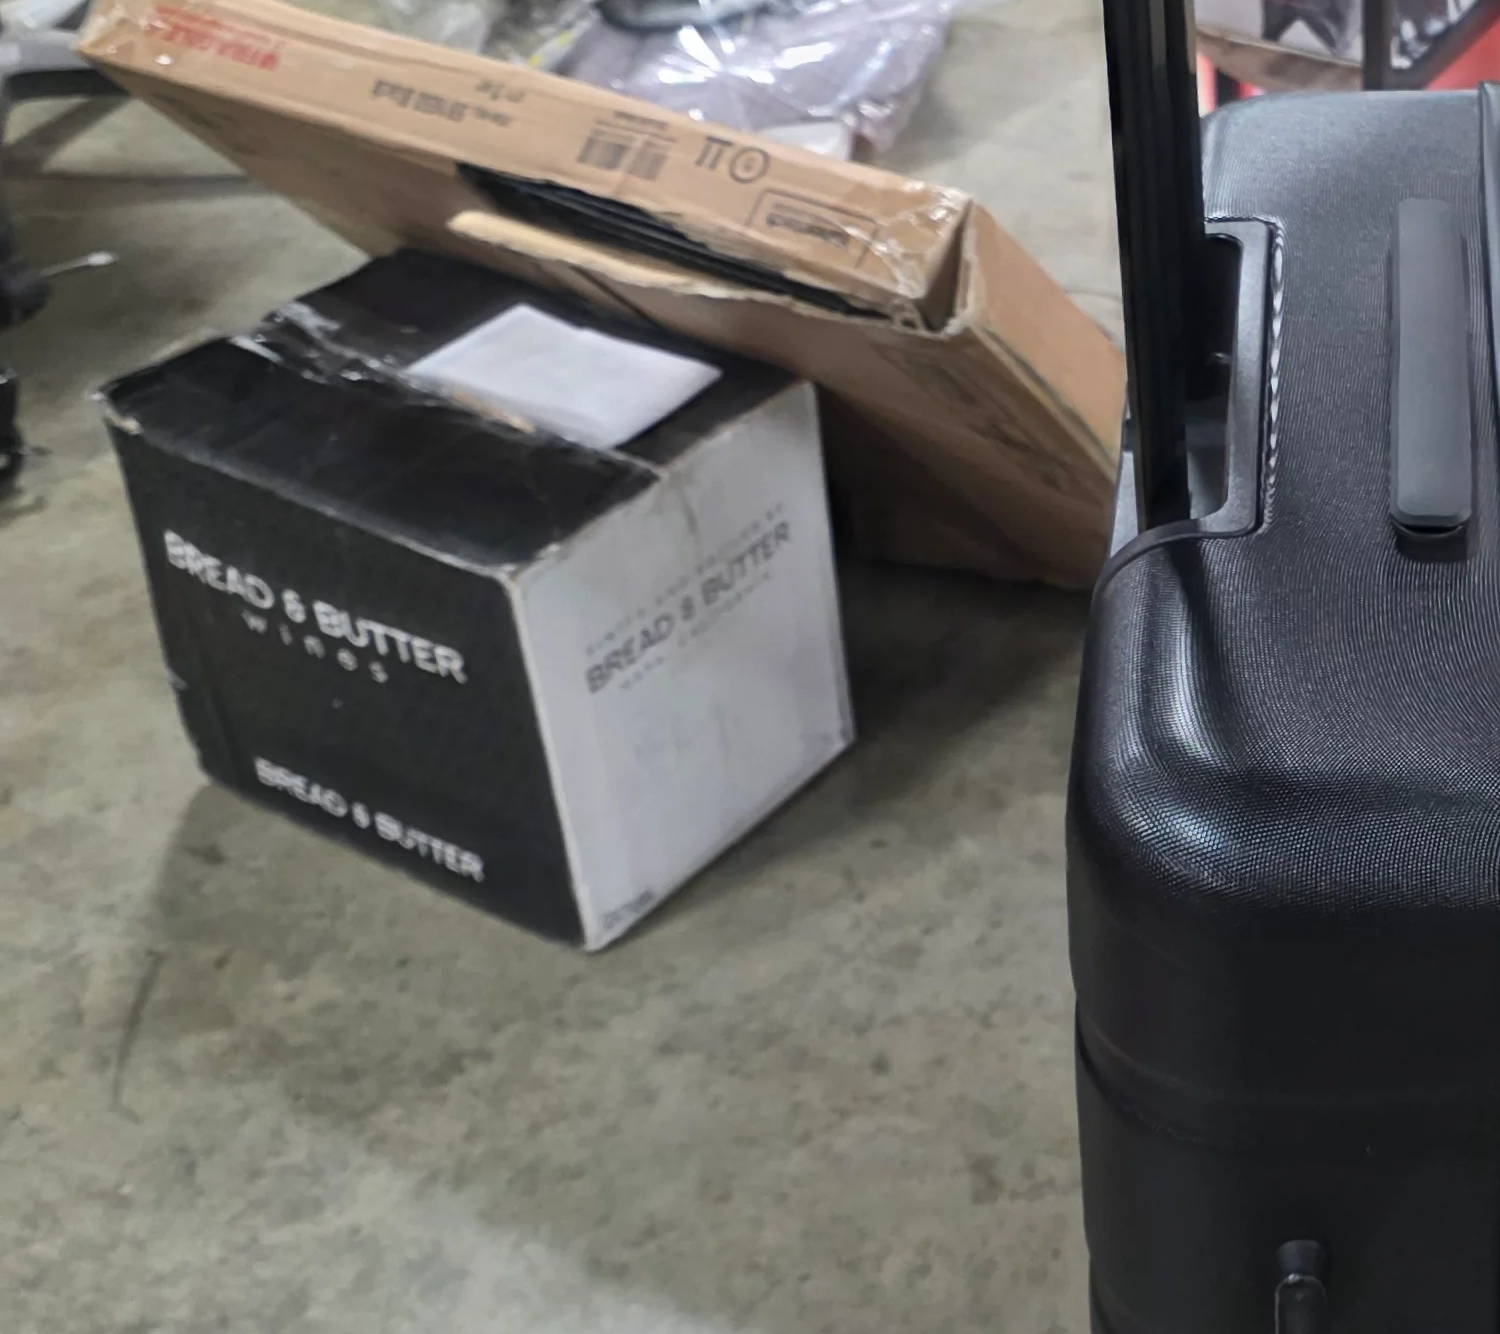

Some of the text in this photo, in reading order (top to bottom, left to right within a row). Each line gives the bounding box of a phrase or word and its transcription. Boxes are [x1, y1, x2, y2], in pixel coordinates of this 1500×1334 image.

[163, 530, 469, 685] BREAD & BUTTER
[585, 613, 676, 695] BREAD
[702, 521, 791, 607] BUTTER
[254, 755, 348, 818] BREAD
[374, 811, 485, 884] BUTTER
